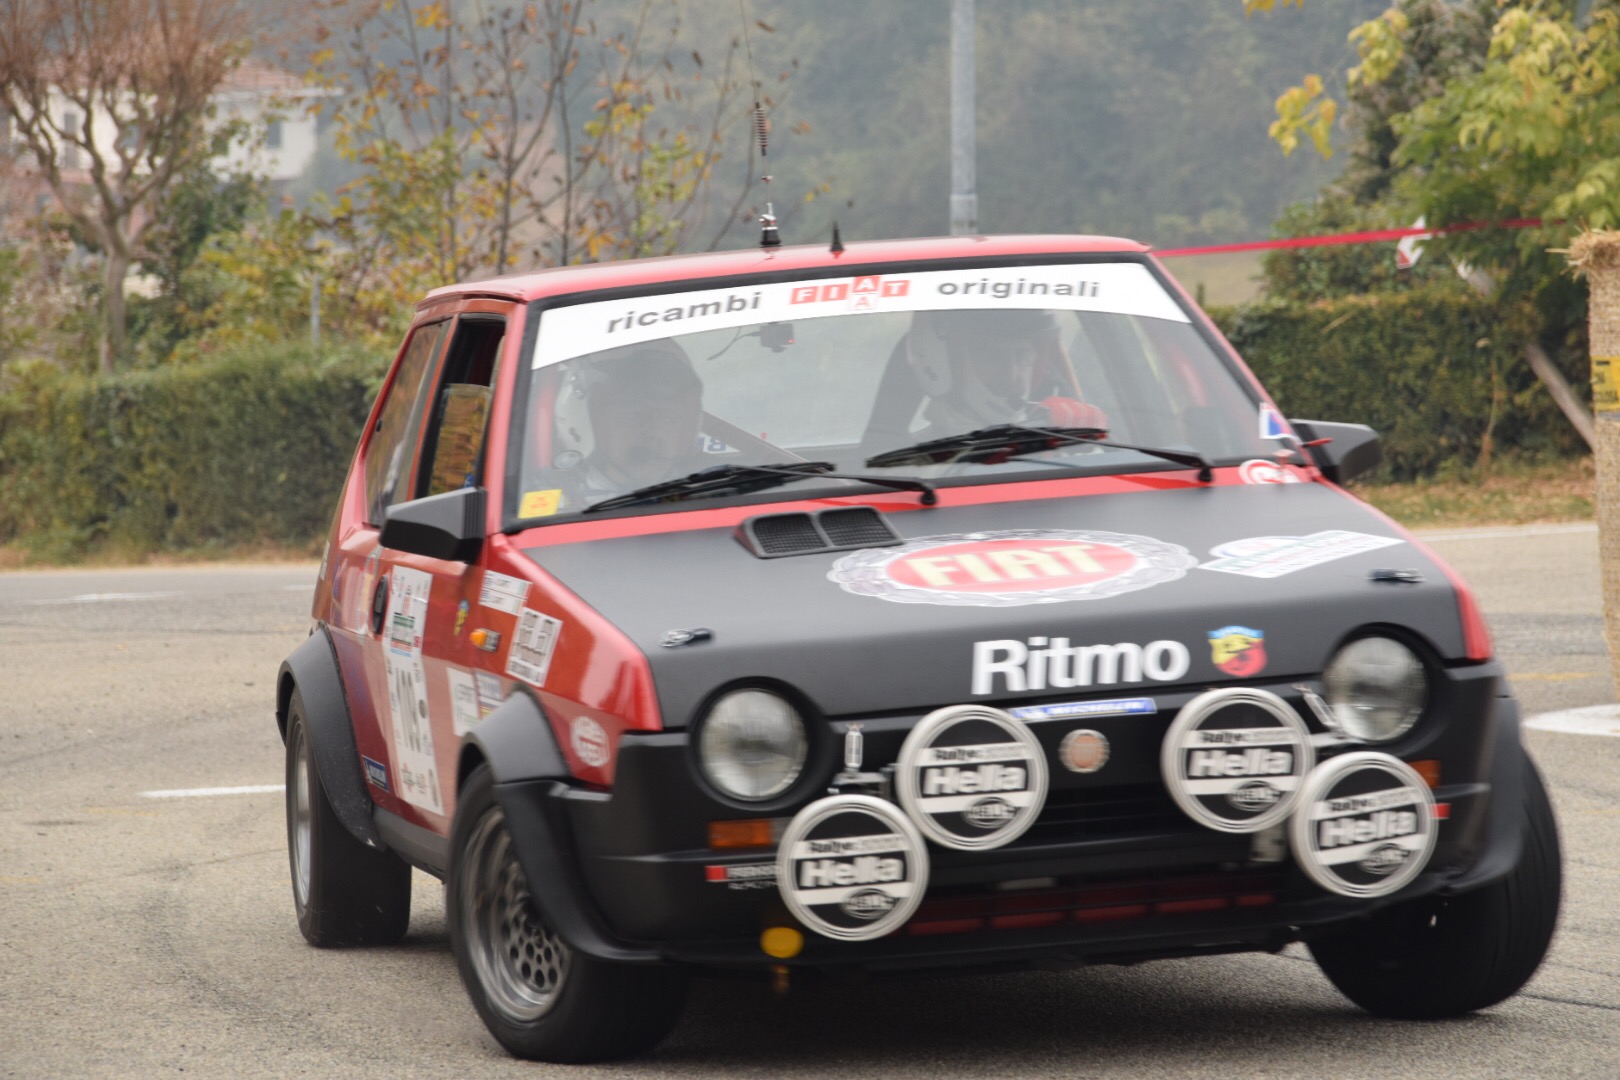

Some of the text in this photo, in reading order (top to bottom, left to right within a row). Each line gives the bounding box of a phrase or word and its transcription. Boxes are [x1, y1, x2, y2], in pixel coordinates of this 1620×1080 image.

[607, 275, 1100, 333] ricambi FIAT originali
[905, 545, 1106, 586] FIAT
[971, 636, 1190, 695] Ritmo
[922, 764, 1027, 795] Hella
[1188, 748, 1293, 777] Hella
[1319, 811, 1418, 848] Hella
[800, 856, 904, 887] Hella
